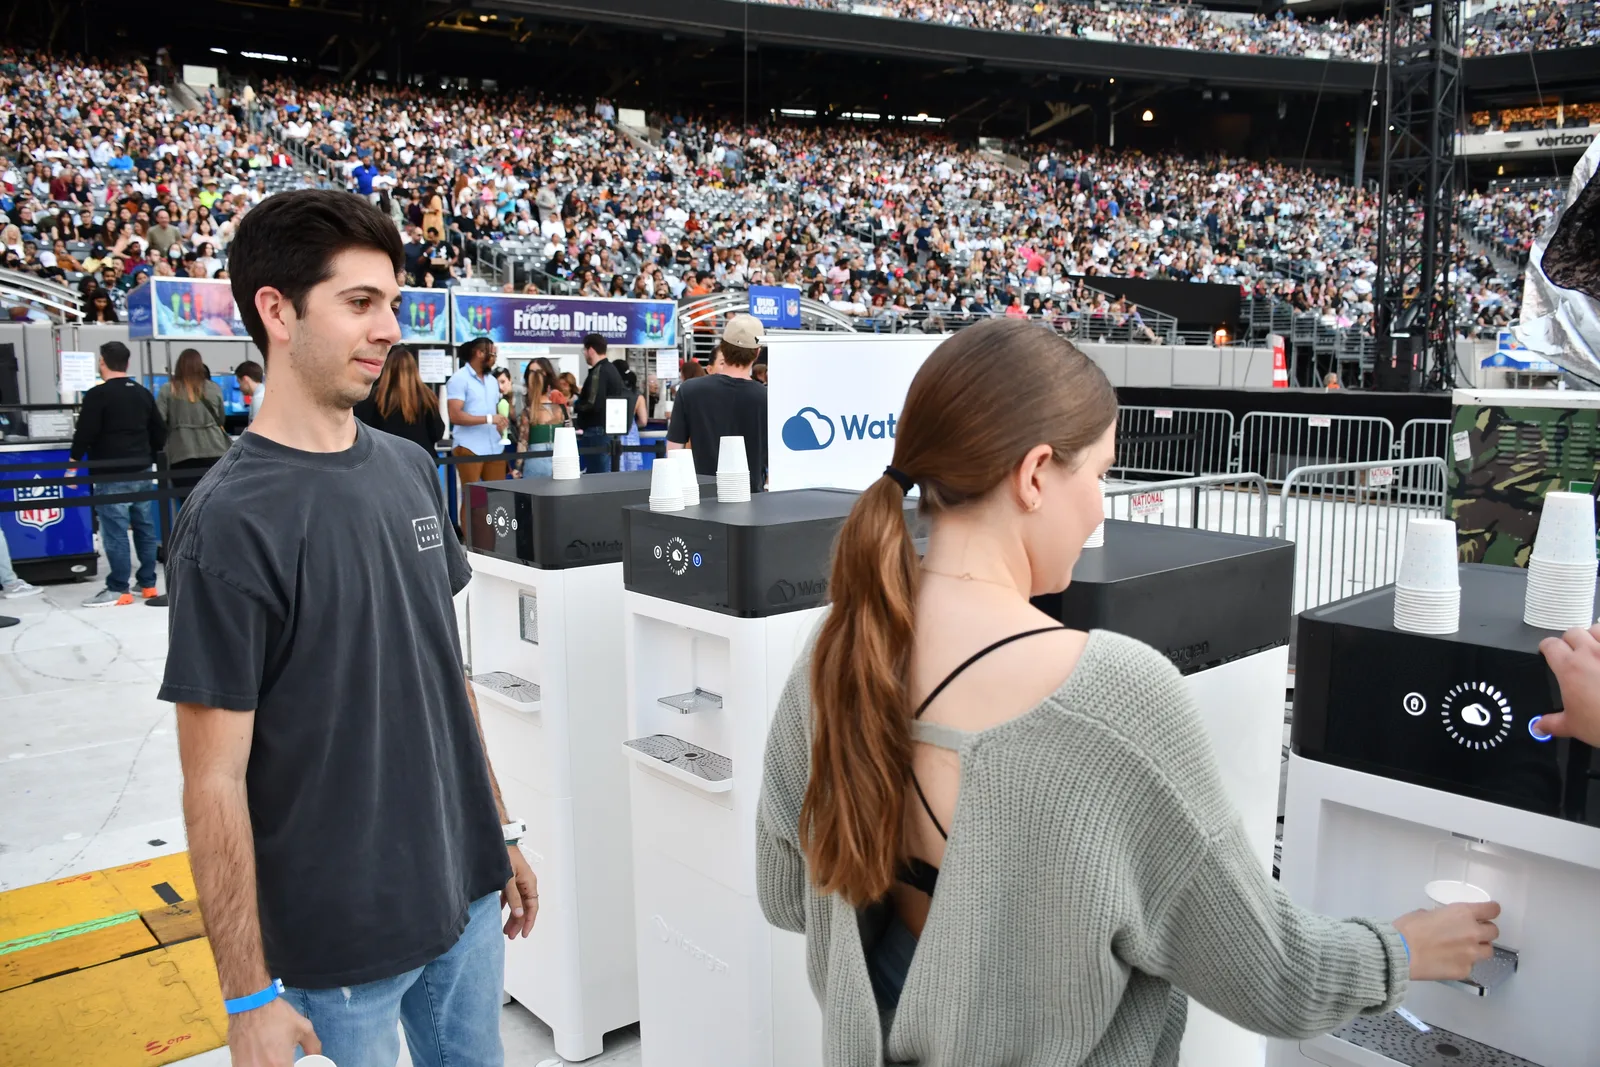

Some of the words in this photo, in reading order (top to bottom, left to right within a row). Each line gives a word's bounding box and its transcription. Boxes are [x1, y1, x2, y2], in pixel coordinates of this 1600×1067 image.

[1536, 133, 1594, 147] verizon
[756, 297, 776, 307] BUD
[753, 305, 779, 316] LIGHT
[513, 309, 570, 331] Frozen
[574, 311, 628, 332] Drinks
[514, 330, 555, 338] MARGARITA
[840, 413, 896, 440] Wat
[1132, 491, 1164, 507] NATIONAL
[23, 507, 58, 522] NFL
